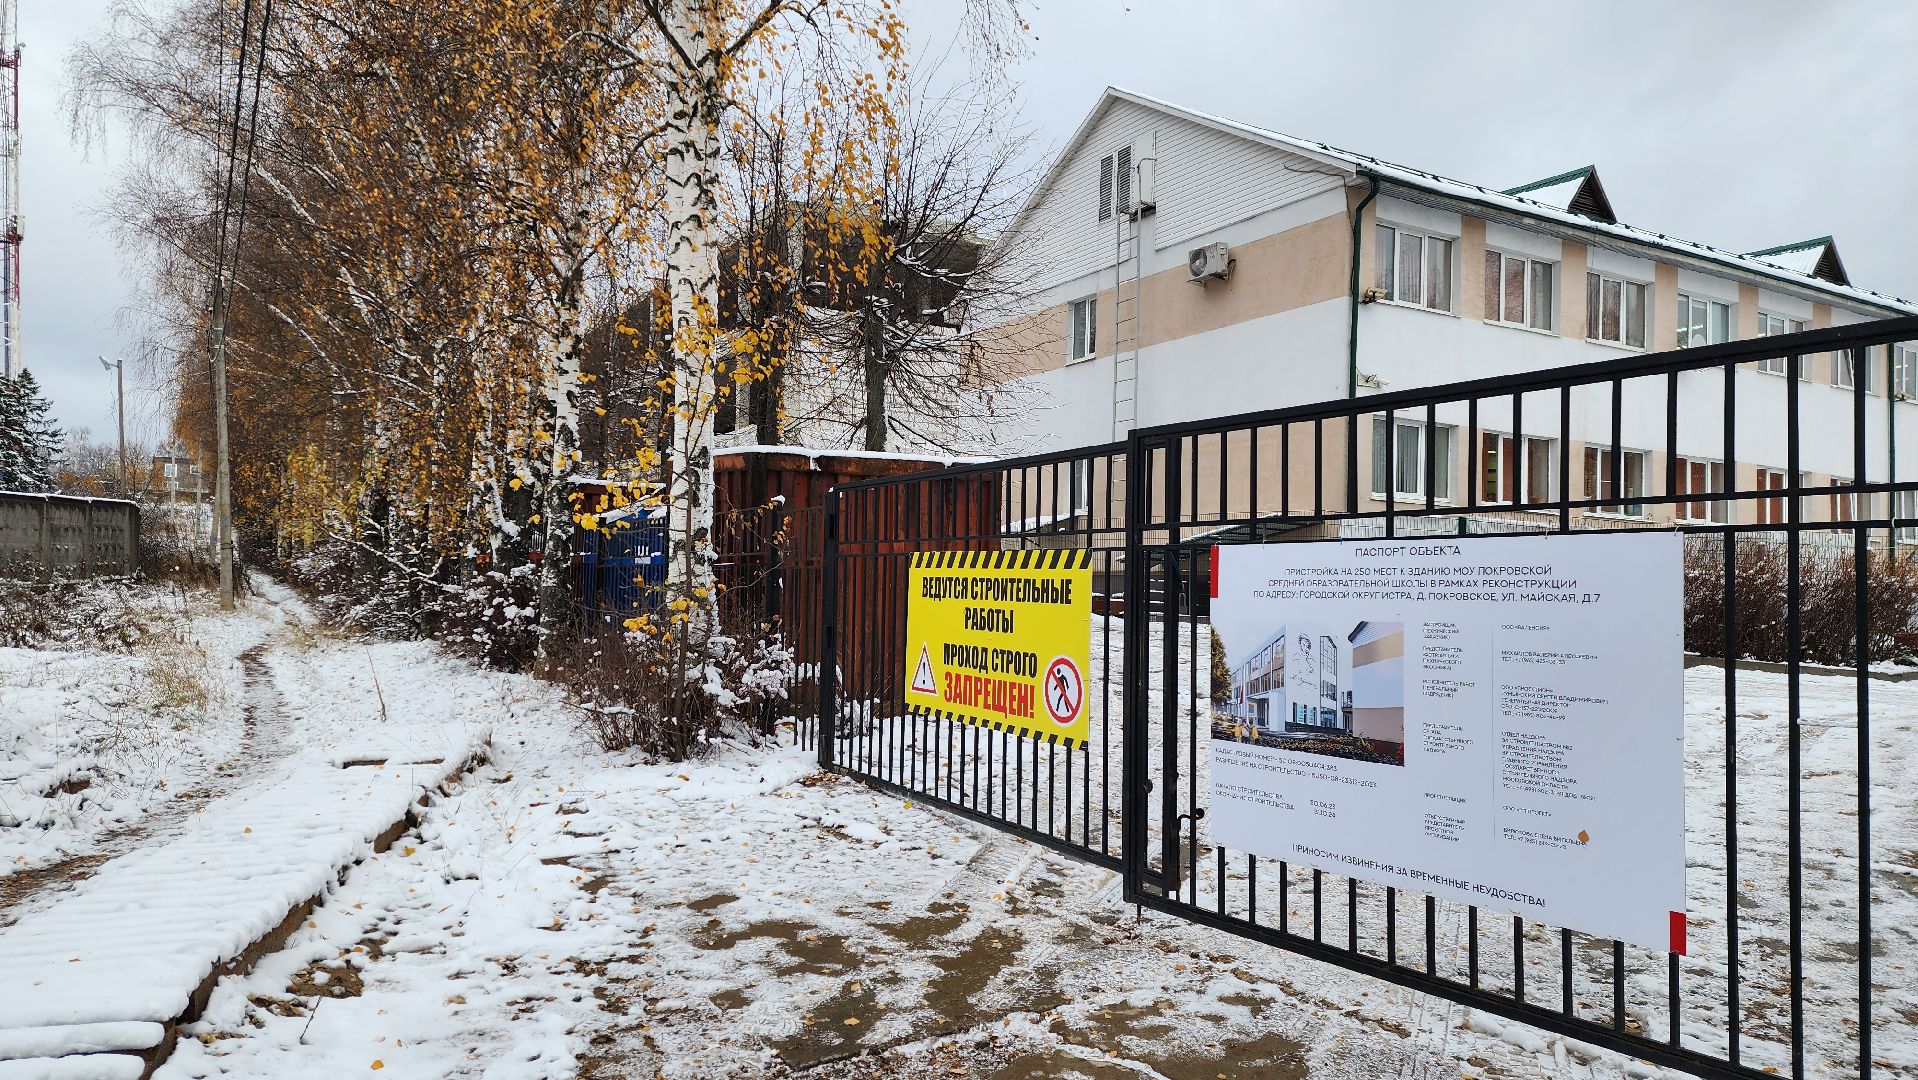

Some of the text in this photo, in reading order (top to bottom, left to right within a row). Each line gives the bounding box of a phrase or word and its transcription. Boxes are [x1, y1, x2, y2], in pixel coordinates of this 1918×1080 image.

[1355, 546, 1461, 557] ПАСПОРТ ОБЪЕКТА
[1268, 578, 1577, 589] СРЕДНЕЙ ОБРАЗОВАТЕЛЬНОЙ ШКОЛЫ В РАМКАХ РЕКОНСТРУКЦИИ
[1285, 567, 1339, 576] ПРИСТРОЙКА
[1341, 568, 1353, 576] НА
[1354, 568, 1371, 576] 250
[1373, 568, 1397, 576] МЕСТ
[1408, 567, 1450, 576] ЗДАНИЮ
[1454, 567, 1475, 576] МОУ
[1478, 565, 1552, 576] ПОКРОВСКОЙ
[922, 576, 1072, 605] ВЕДУТСЯ СТРОИТЕЛЬНЫЕ
[1253, 590, 1265, 598] ПО
[1300, 589, 1349, 599] ГОРОДСКОЙ
[1352, 591, 1380, 599] ОКРУГ
[1381, 592, 1415, 601] ИСТРА,
[1417, 592, 1426, 601] Д.
[1429, 592, 1499, 602] ПОКРОВСКОЕ,
[1501, 592, 1518, 602] УЛ.
[1520, 591, 1579, 603] МАЙСКАЯ,
[1582, 593, 1601, 604] Д.7
[964, 607, 1014, 633] РАБОТЫ
[943, 643, 1038, 678] ПРОХОД СТРОГО
[944, 671, 1035, 719] ЗАПРЕЩЕН!
[1292, 844, 1546, 907] ПРИНОСИМ ИЗВИНЕНИЯ ЗА ВРЕМЕННЫЕ НЕУДОБСТВА!
